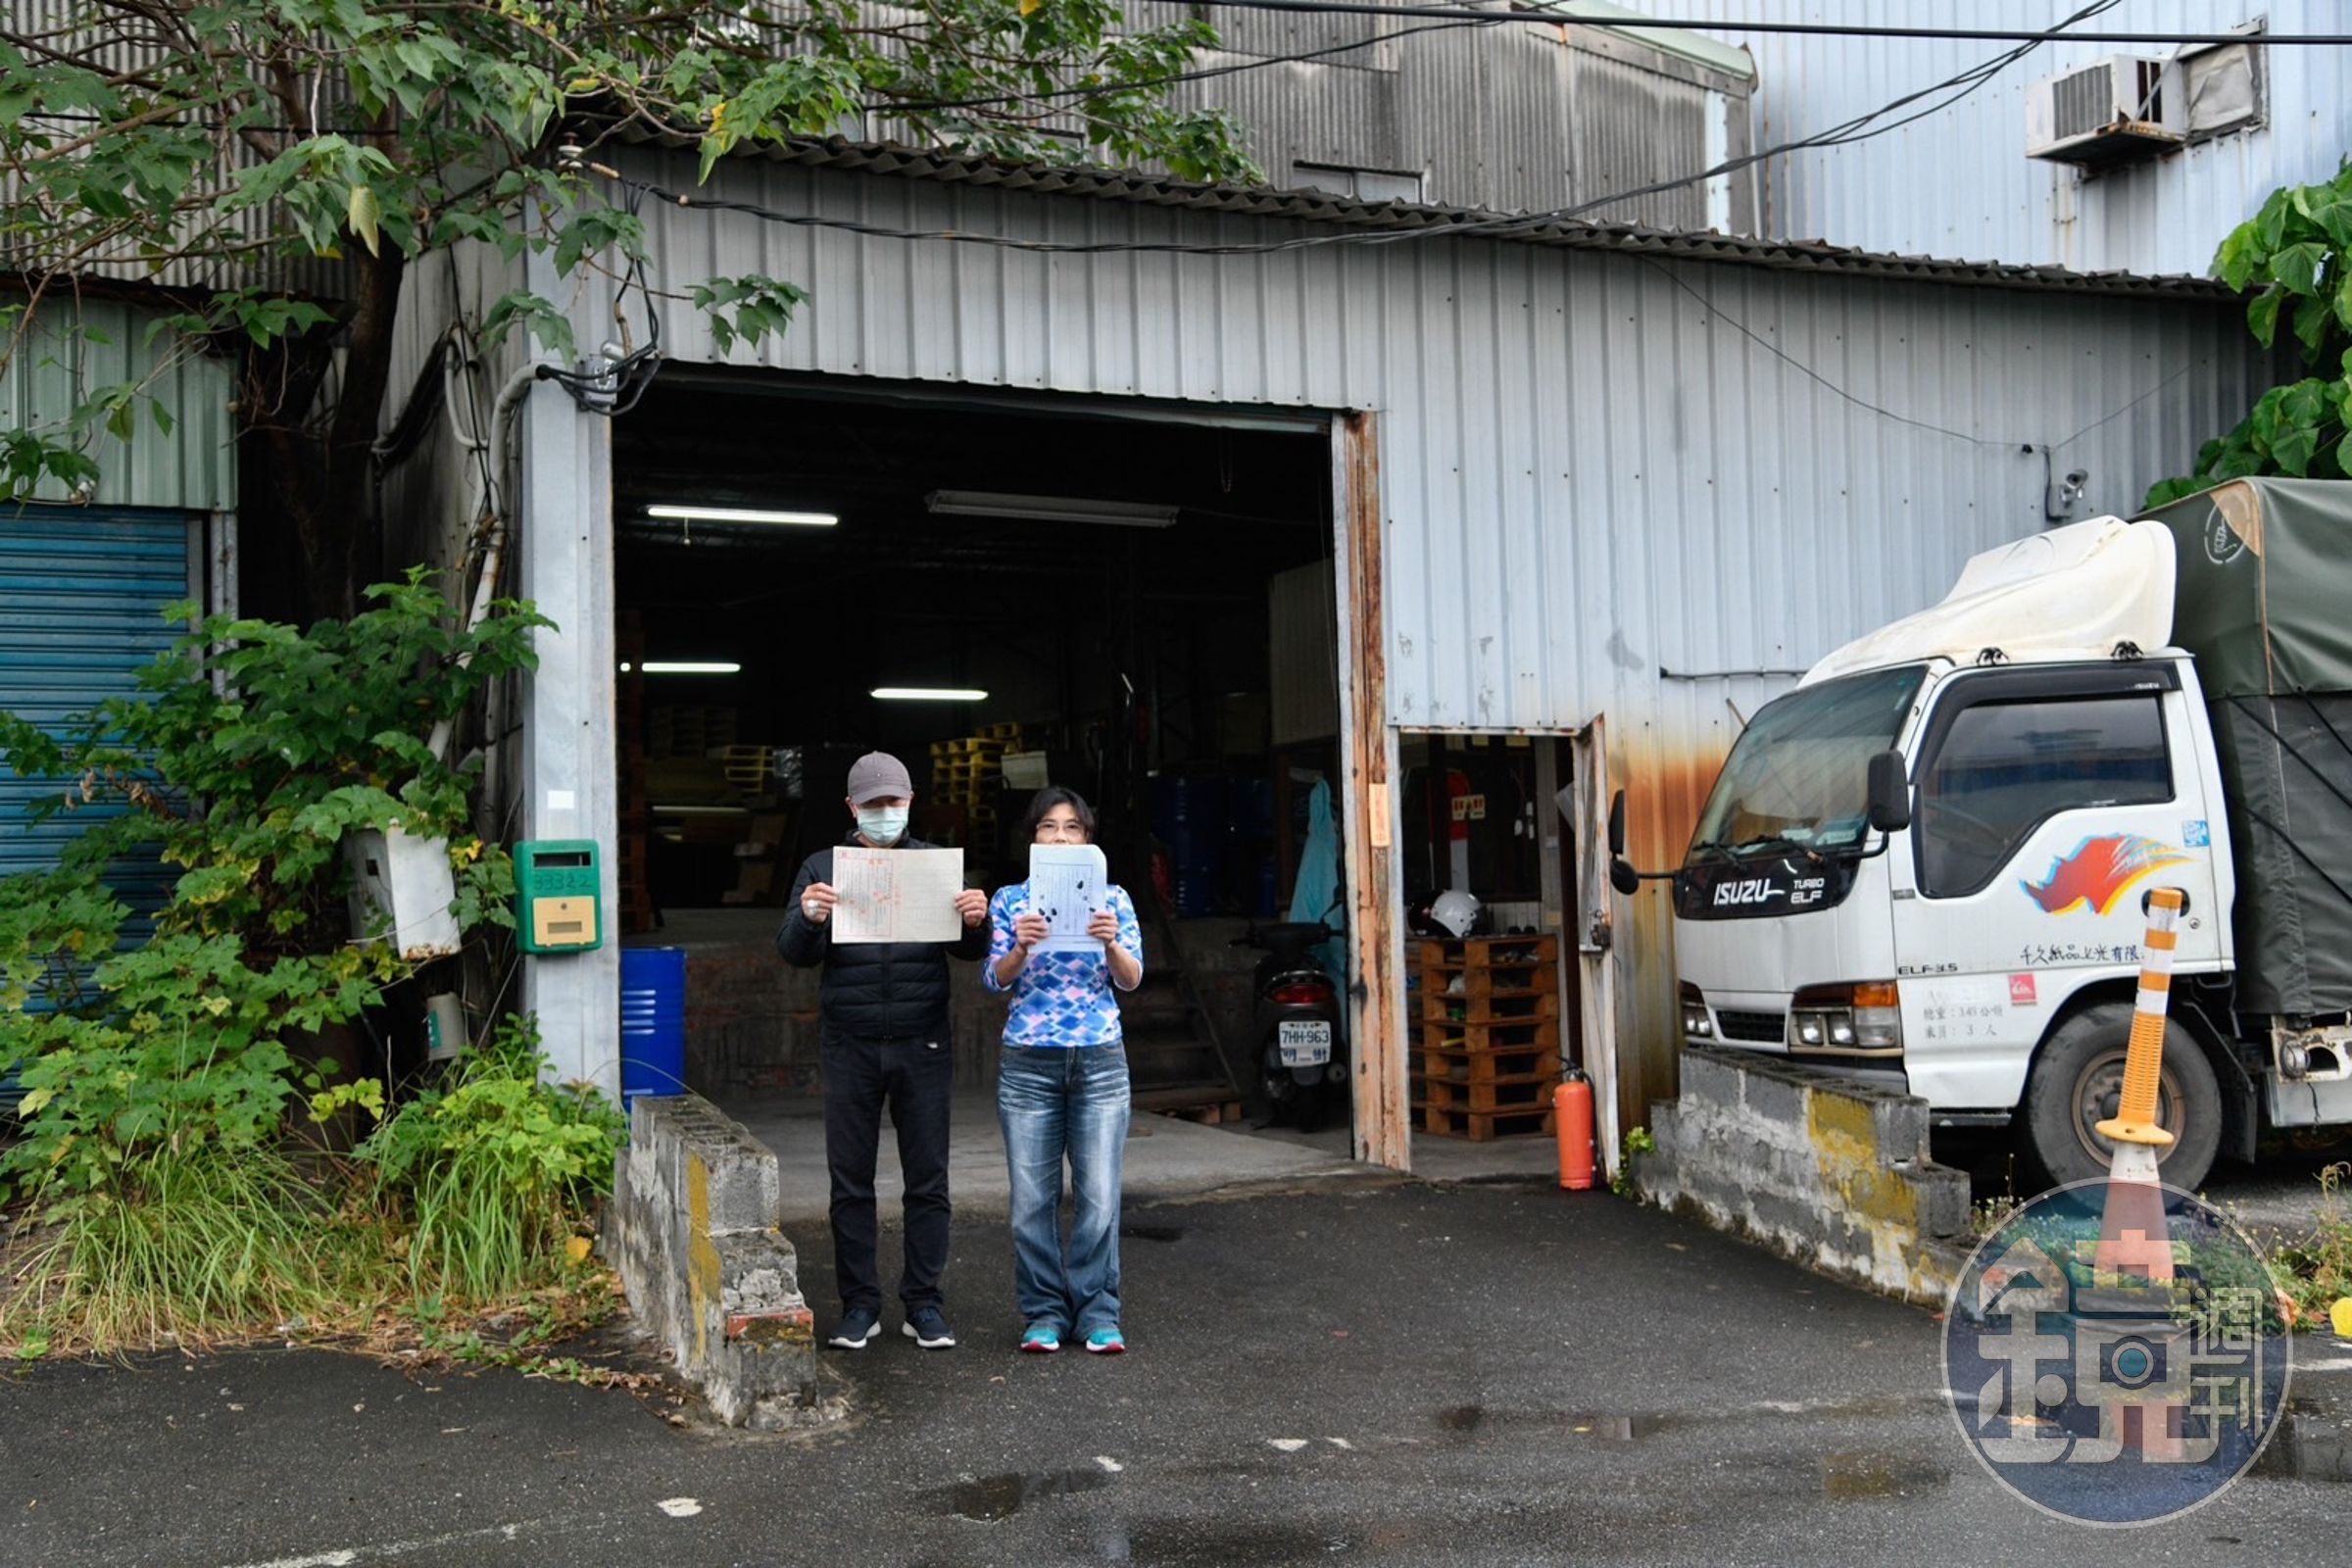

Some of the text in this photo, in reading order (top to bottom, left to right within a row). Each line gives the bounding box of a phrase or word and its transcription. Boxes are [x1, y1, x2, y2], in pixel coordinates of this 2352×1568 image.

[1793, 877, 1825, 890] TURBO
[1713, 878, 1785, 906] ISUZU
[1790, 890, 1823, 905] ELF
